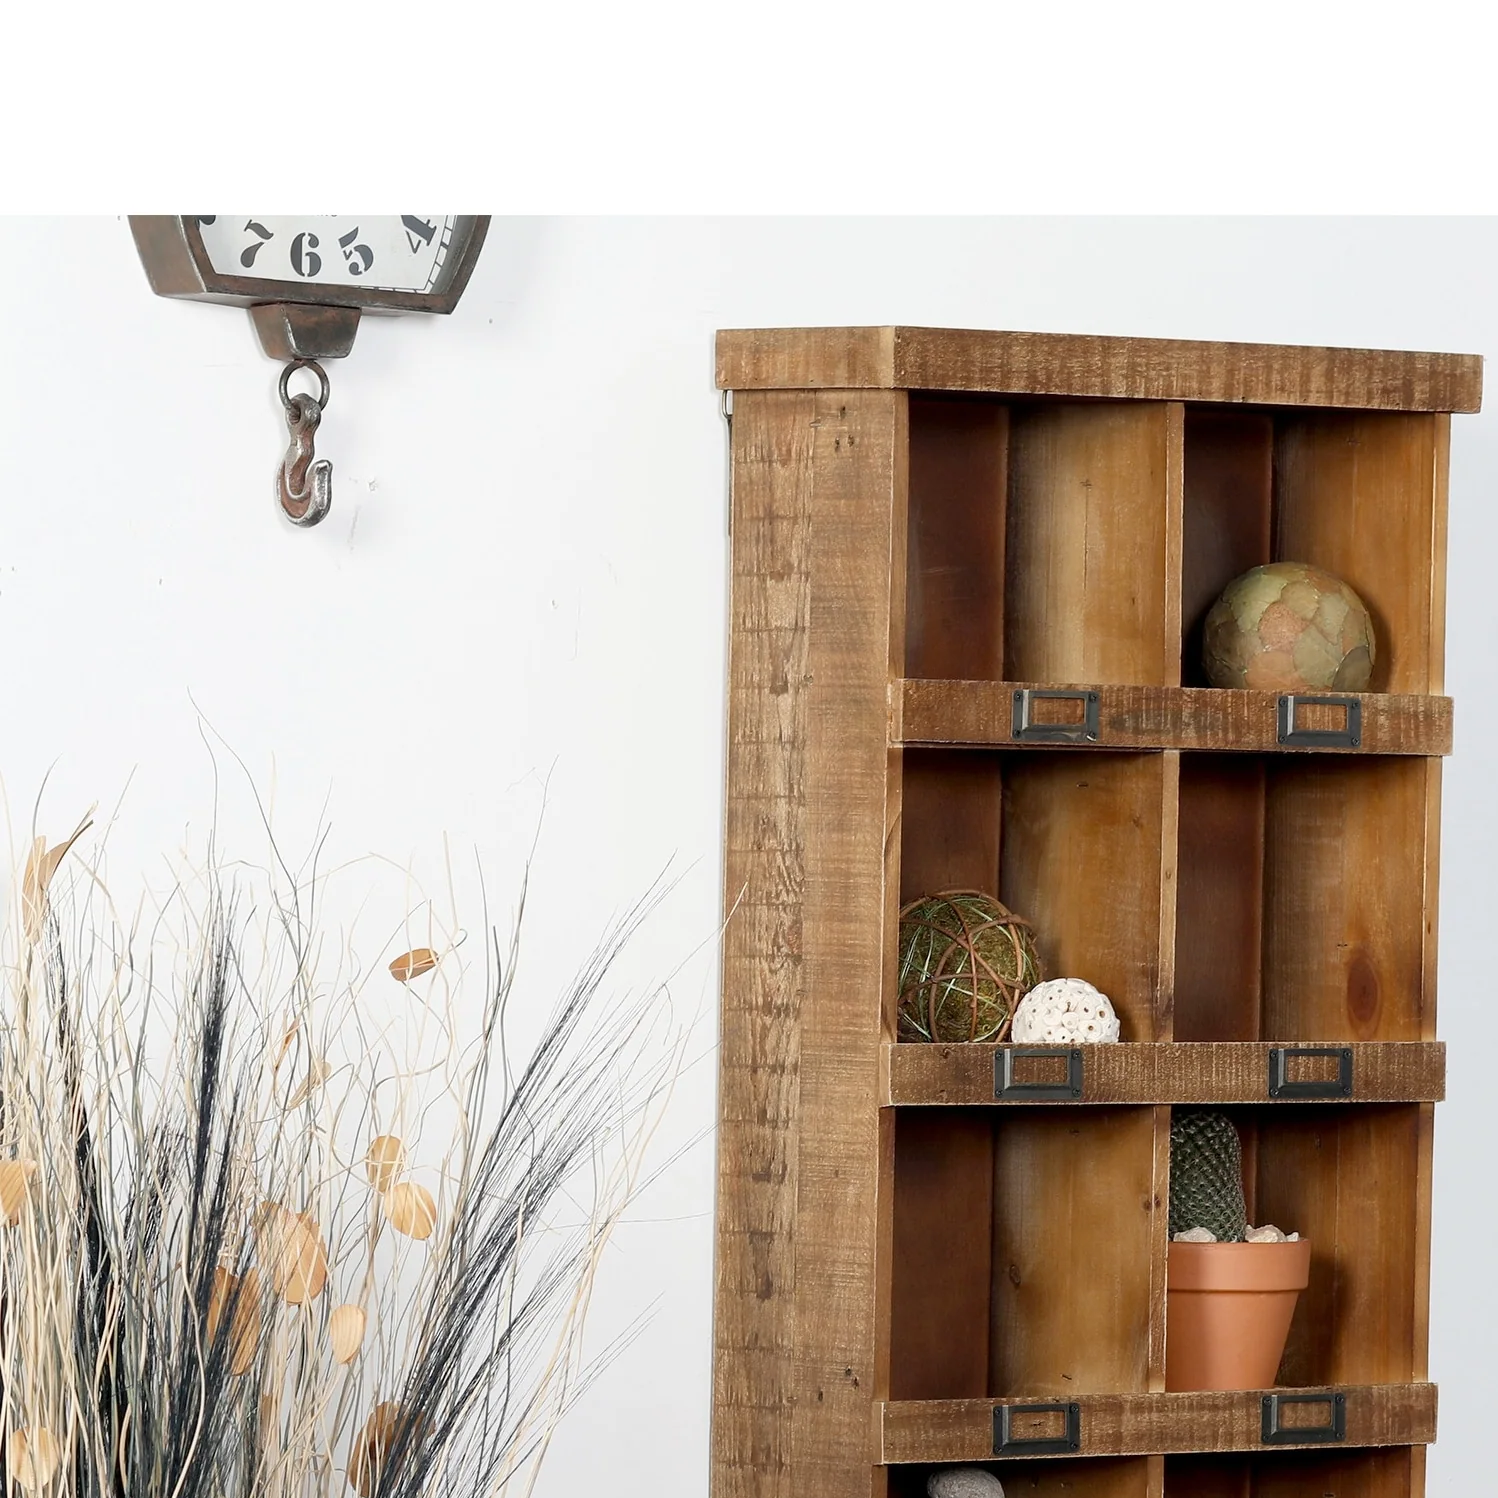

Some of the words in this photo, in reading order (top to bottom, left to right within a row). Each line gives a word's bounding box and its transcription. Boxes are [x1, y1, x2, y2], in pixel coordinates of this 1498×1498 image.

[240, 219, 274, 268] 7
[290, 232, 322, 277] 6
[338, 226, 375, 277] 5
